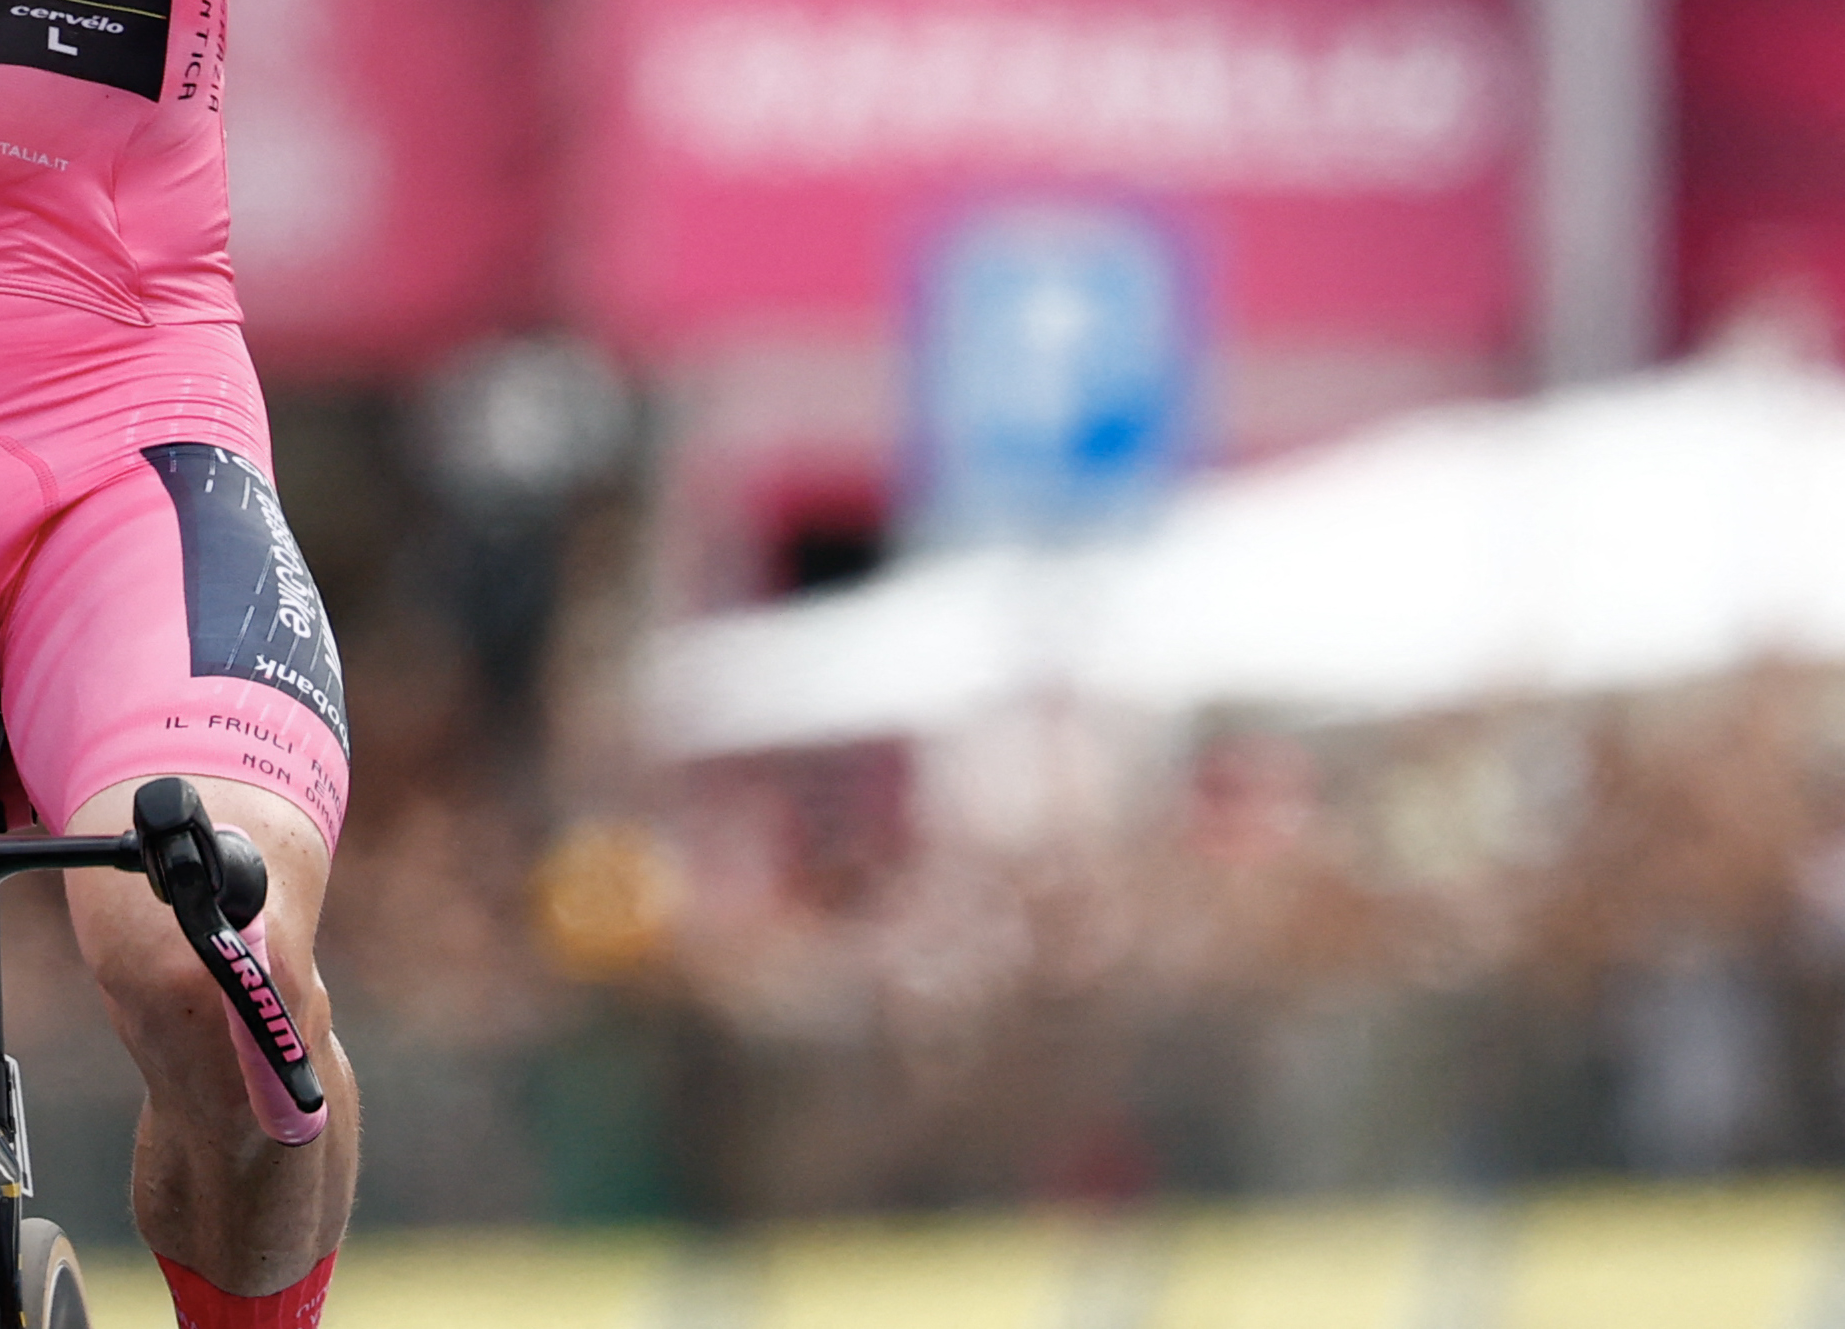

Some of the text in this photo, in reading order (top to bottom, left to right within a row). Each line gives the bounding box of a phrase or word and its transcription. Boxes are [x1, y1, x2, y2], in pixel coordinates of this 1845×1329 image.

[10, 5, 124, 34] cervélo
[255, 654, 351, 761] bobank
[166, 716, 188, 729] IL
[208, 715, 293, 754] FRIULI
[243, 753, 291, 785] NON
[211, 930, 305, 1063] SRAM
